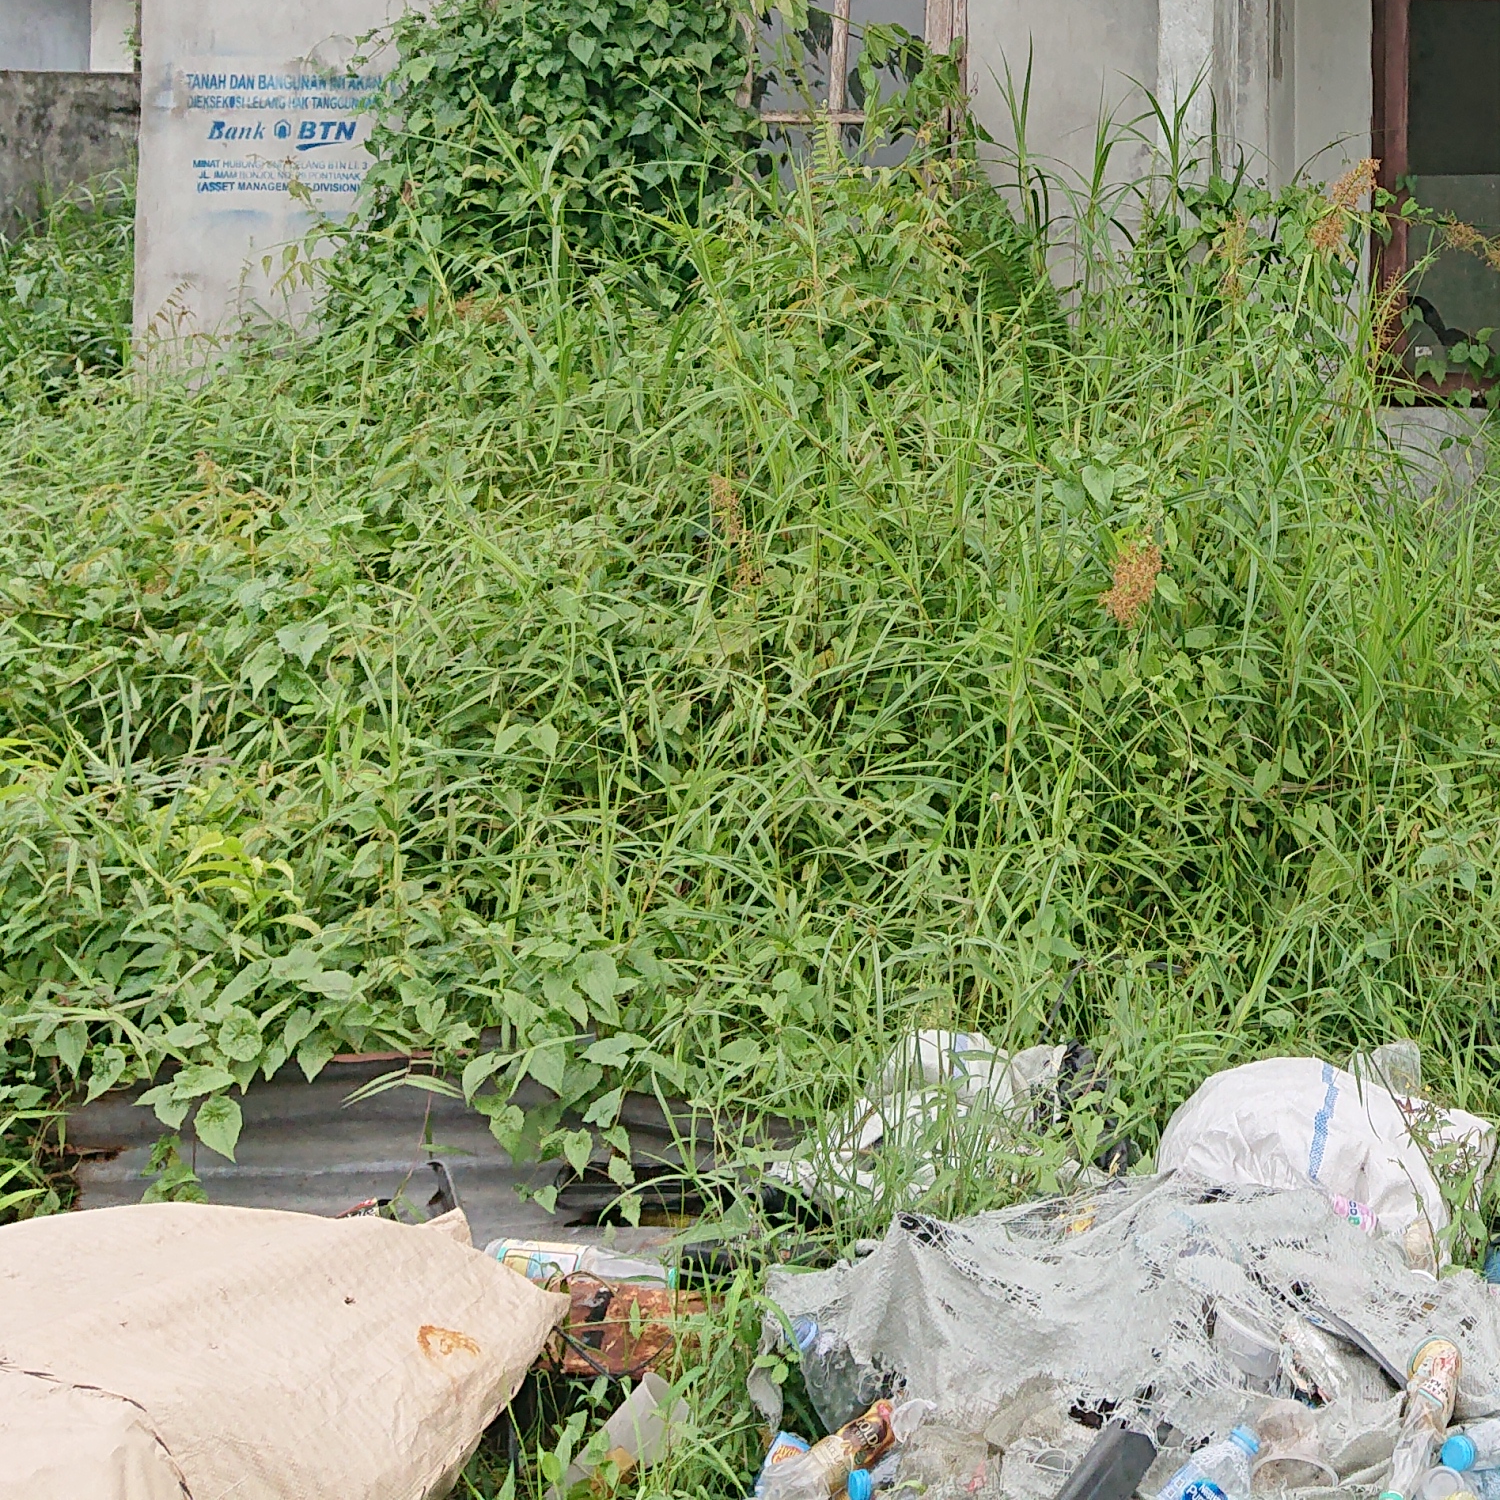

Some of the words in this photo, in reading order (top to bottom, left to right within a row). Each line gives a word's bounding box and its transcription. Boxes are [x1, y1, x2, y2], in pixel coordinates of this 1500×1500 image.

[186, 73, 227, 90] TANAH
[230, 74, 255, 90] DAN
[207, 120, 267, 140] Bank
[297, 121, 357, 141] BTN
[362, 161, 368, 170] 3
[197, 182, 235, 193] (ASSET
[238, 183, 311, 192] MANAGEMT
